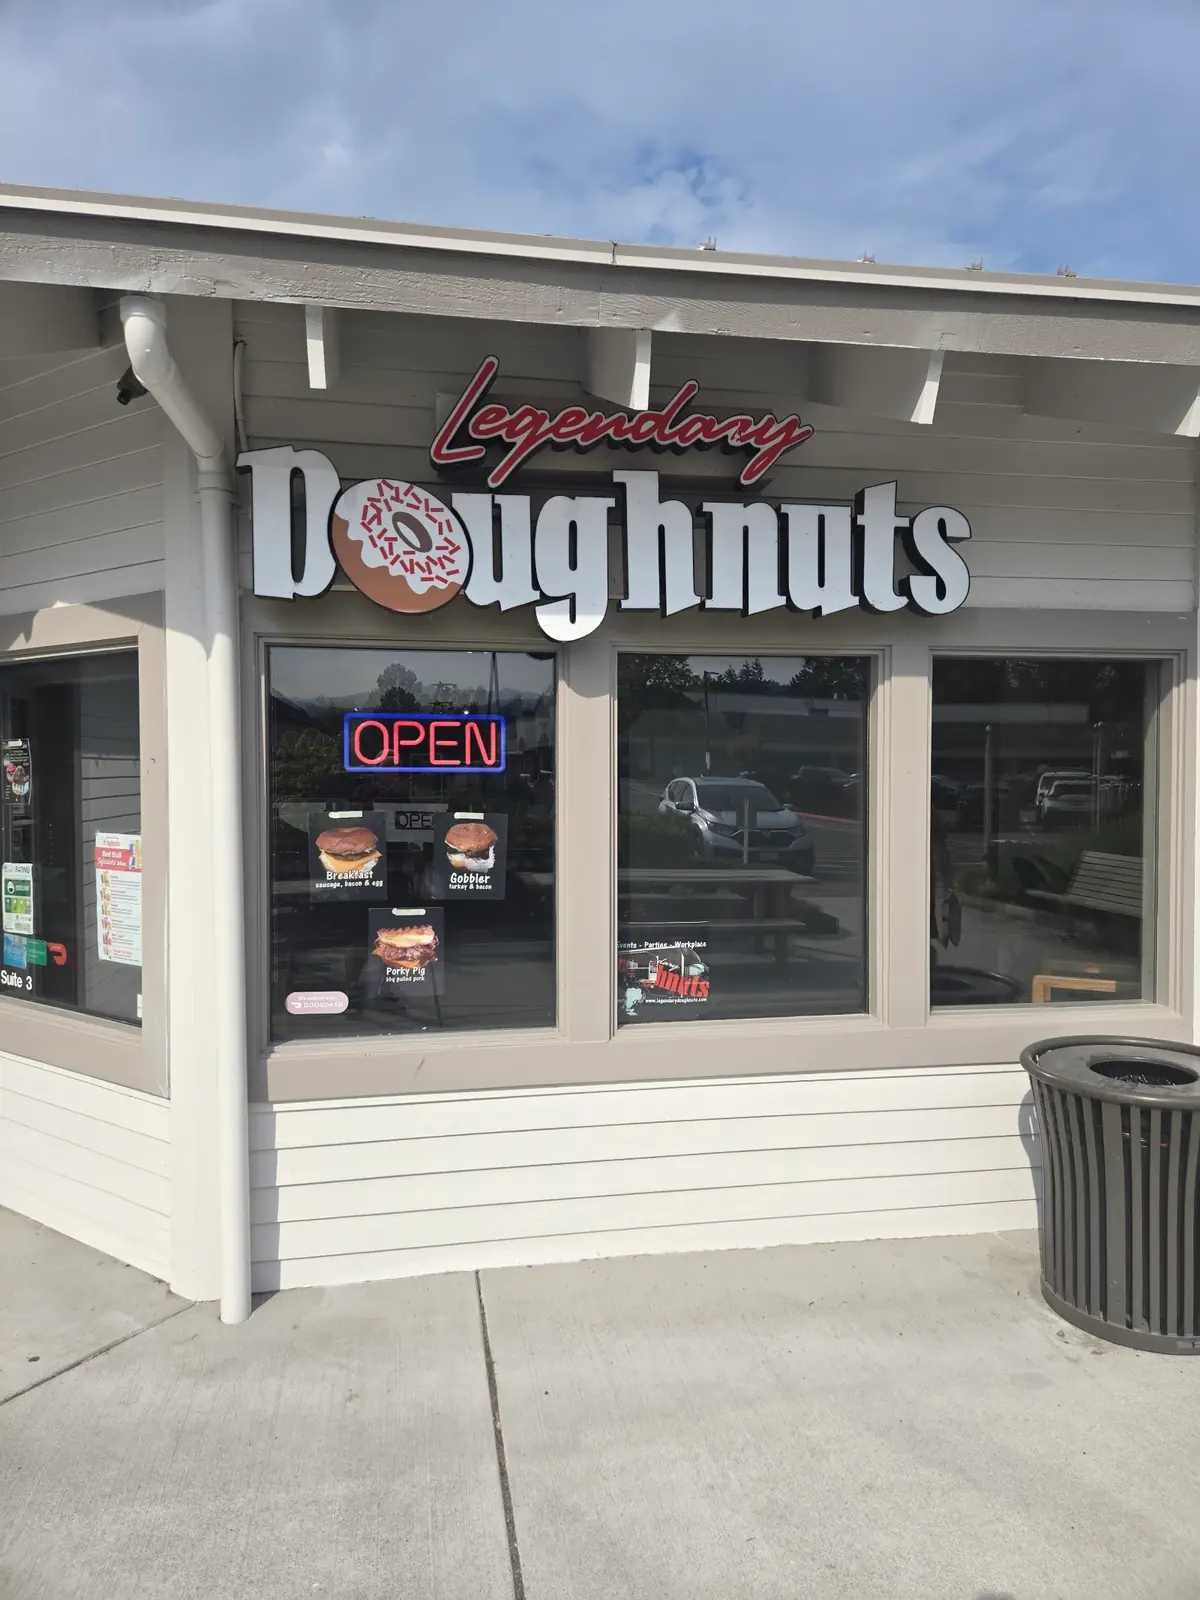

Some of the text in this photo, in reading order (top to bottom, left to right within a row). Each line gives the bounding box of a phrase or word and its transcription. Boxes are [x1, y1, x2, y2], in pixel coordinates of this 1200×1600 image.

[430, 354, 814, 487] Legendary
[235, 444, 971, 642] Doughnuts
[354, 720, 497, 766] OPEN
[396, 811, 434, 830] OPE
[326, 870, 374, 880] Breakfast
[450, 872, 490, 883] Gobbler
[449, 883, 467, 891] turkey
[674, 940, 707, 949] Workplace
[386, 966, 426, 976] Porky Pig
[1, 969, 33, 991] Suite 3
